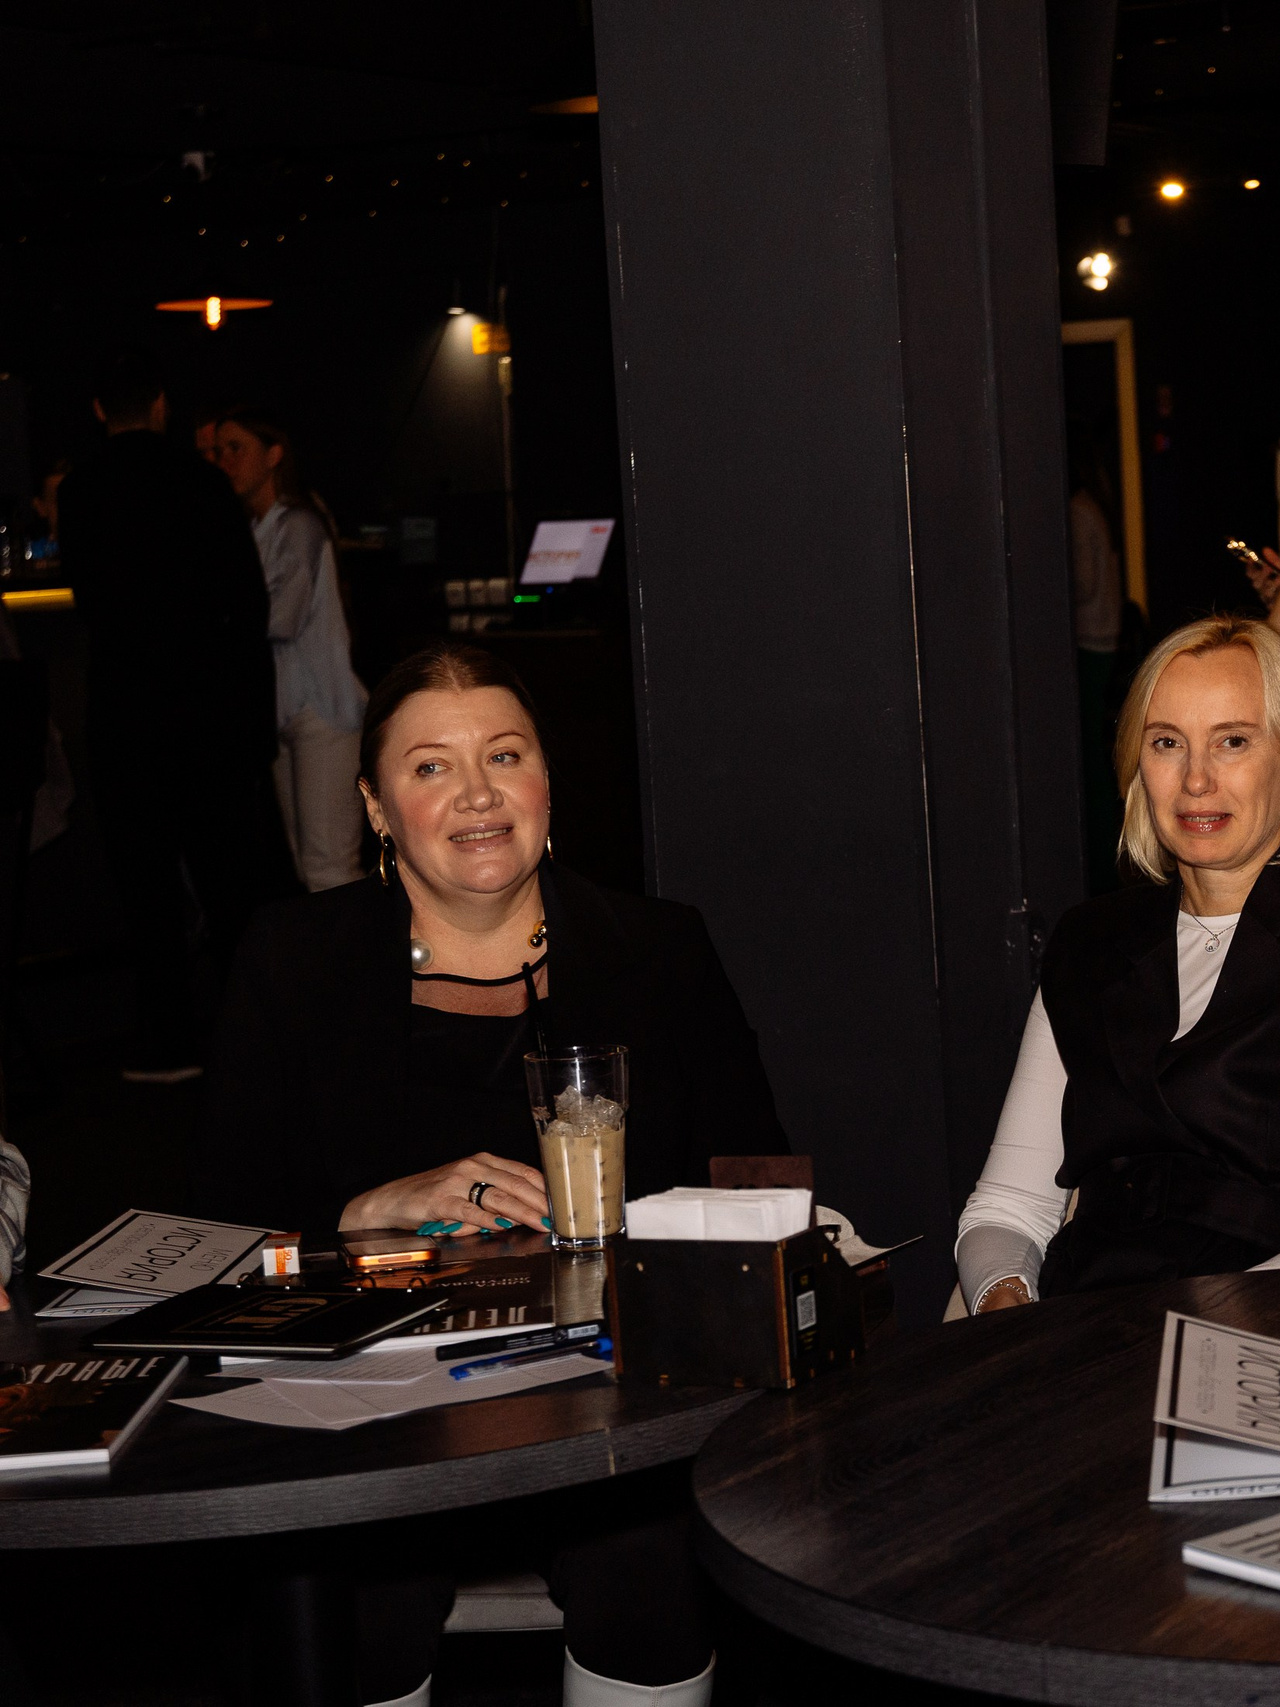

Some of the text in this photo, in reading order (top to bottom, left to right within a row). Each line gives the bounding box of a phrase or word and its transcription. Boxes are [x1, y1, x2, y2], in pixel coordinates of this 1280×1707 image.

[114, 1226, 213, 1282] ИСТОРИЯ
[190, 1249, 235, 1272] МЕНЮ
[412, 1306, 527, 1333] ЛЕГЕ
